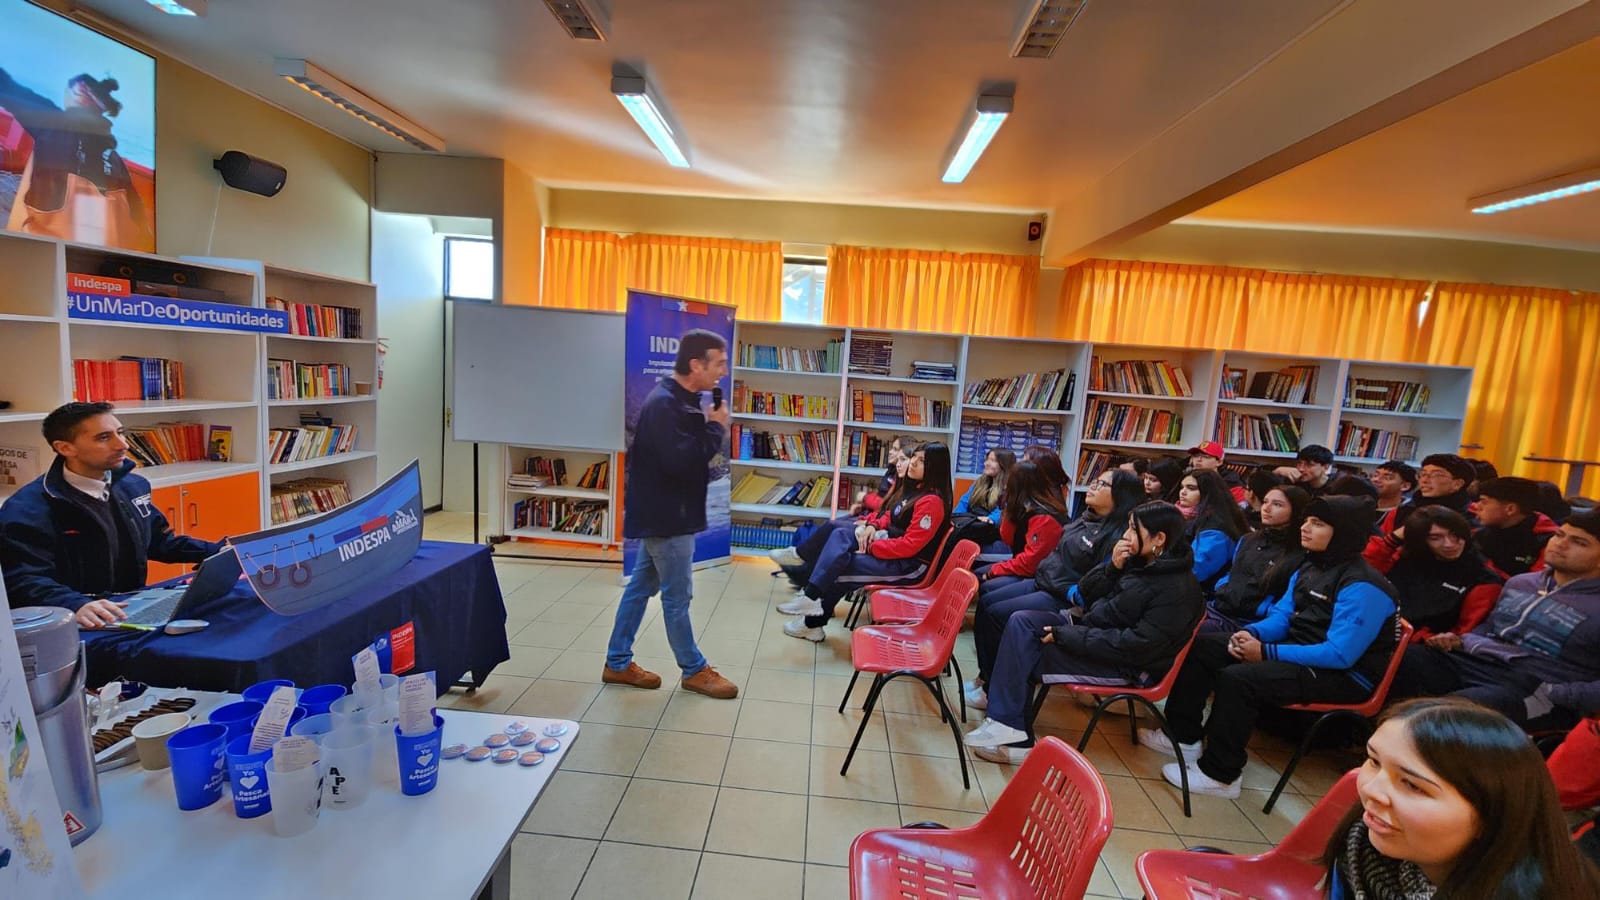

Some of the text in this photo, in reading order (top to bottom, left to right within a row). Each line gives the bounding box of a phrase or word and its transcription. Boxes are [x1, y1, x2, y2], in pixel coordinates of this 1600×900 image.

[74, 276, 122, 292] Indespa
[66, 295, 284, 328] #UnMarDeOportunidades
[650, 336, 680, 354] IND
[338, 528, 391, 562] INDESPA
